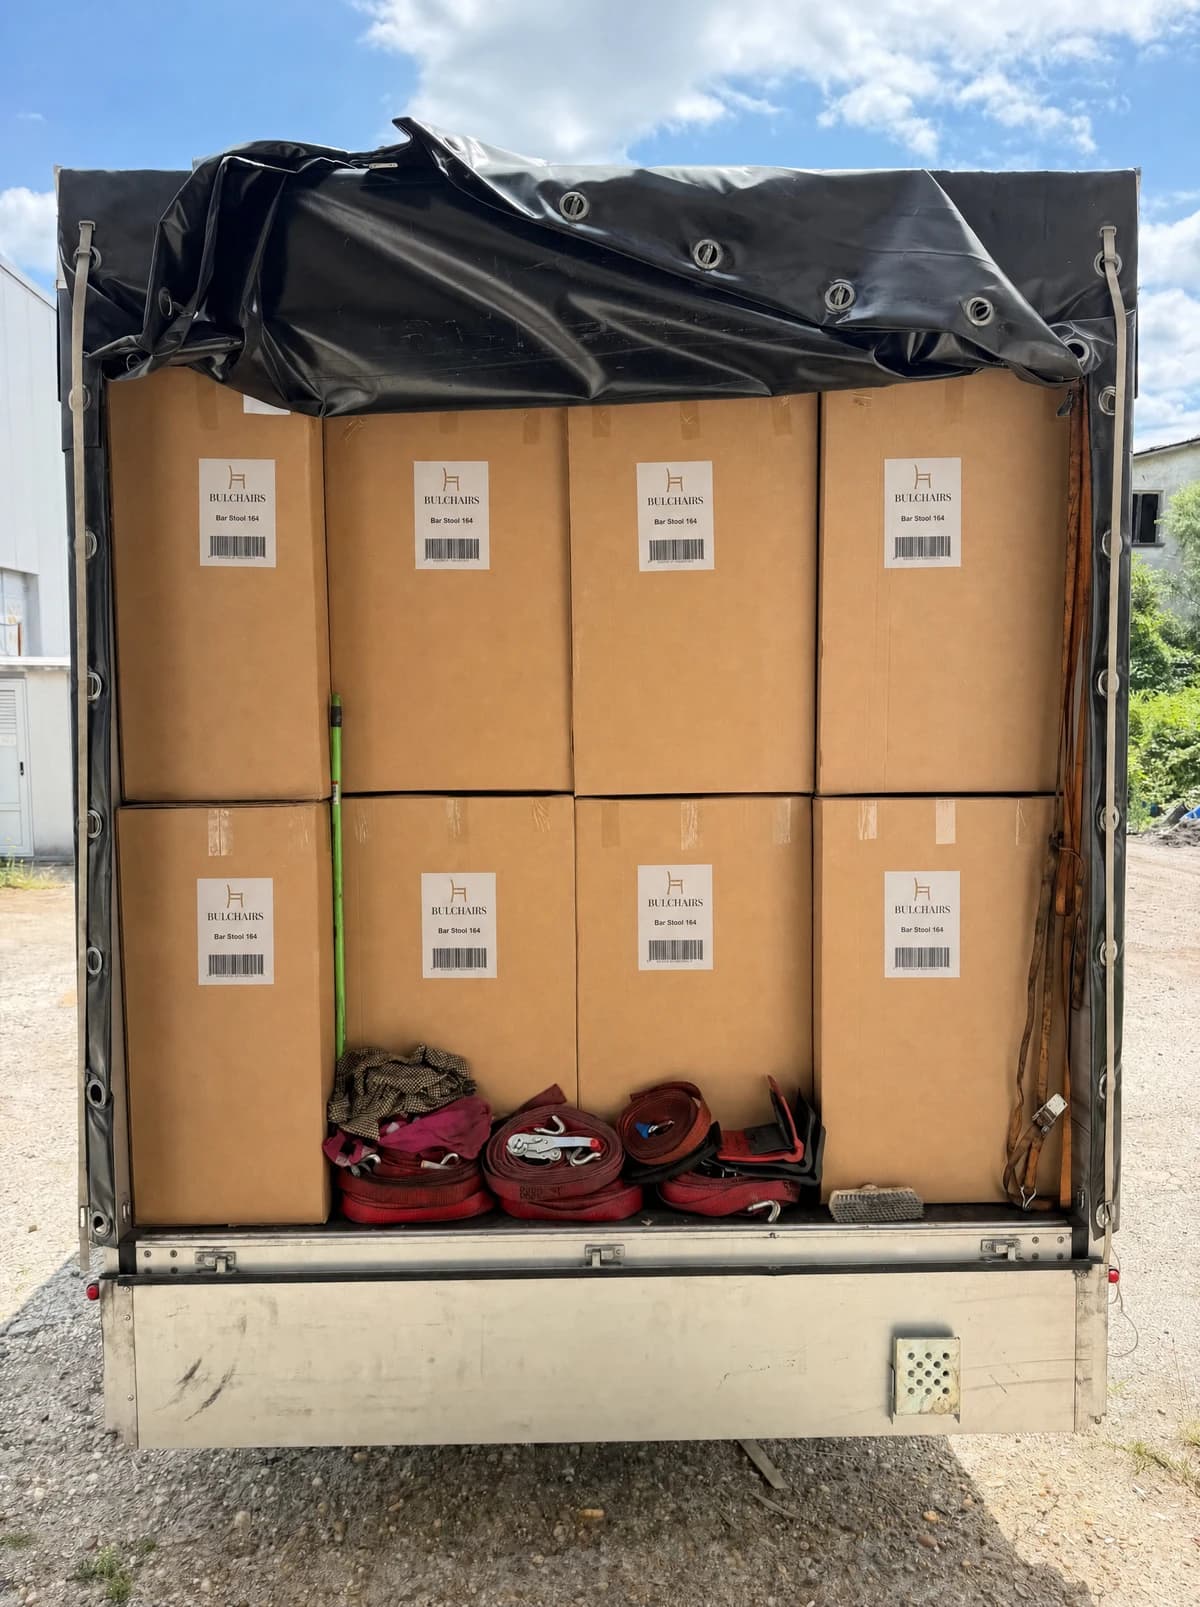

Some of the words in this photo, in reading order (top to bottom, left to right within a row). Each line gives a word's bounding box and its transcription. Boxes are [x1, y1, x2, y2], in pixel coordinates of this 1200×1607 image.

[209, 493, 267, 503] BULCHAIRS
[424, 496, 480, 505] BULCHAIRS
[647, 497, 704, 507] BULCHAIRS
[894, 493, 952, 503] BULCHAIRS
[648, 899, 704, 908] BULCHAIRS
[431, 906, 488, 916] BULCHAIRS
[894, 906, 951, 915] BULCHAIRS
[207, 912, 264, 921] BULCHAIRS
